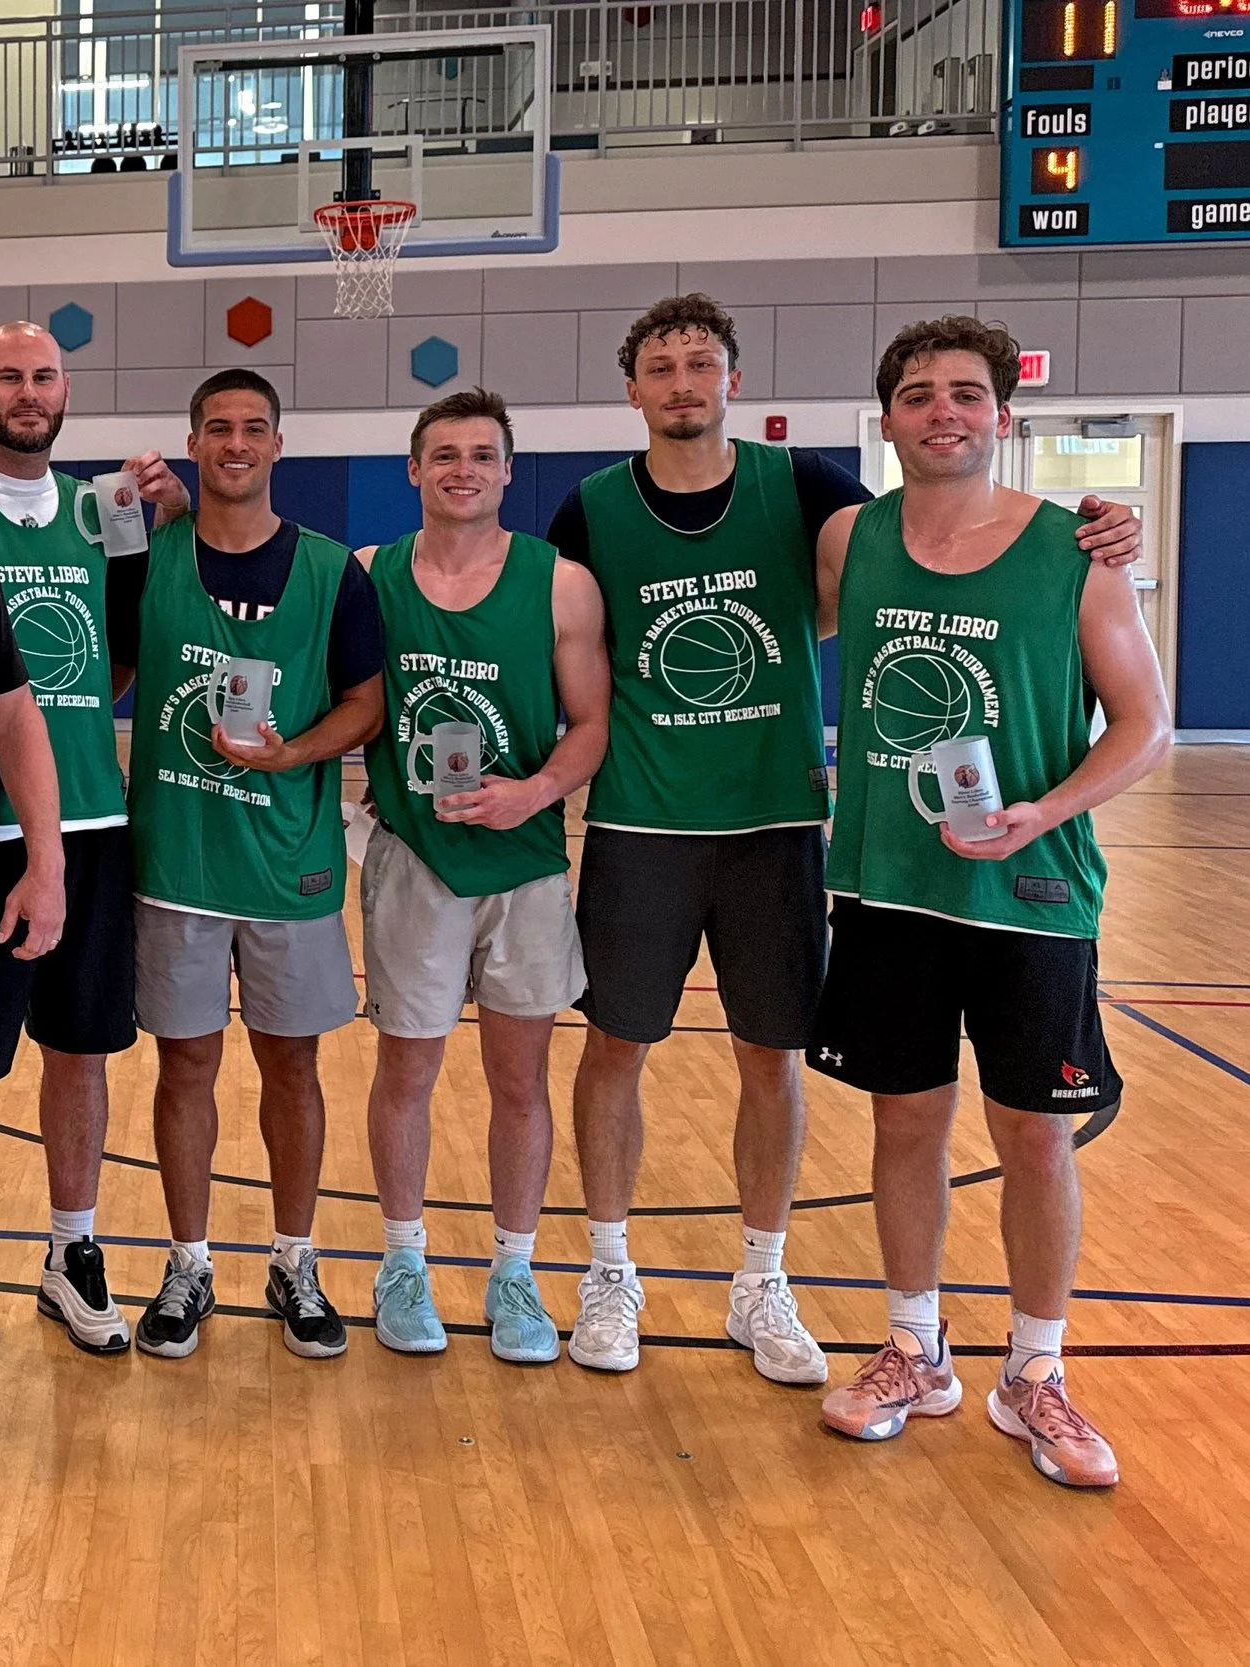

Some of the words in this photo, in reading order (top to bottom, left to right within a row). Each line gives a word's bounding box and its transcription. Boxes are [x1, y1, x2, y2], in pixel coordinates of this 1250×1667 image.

[1187, 56, 1250, 86] perio
[1026, 107, 1087, 136] fouls
[1185, 101, 1250, 130] playe
[1047, 150, 1076, 189] 4
[1032, 209, 1078, 230] won
[1020, 355, 1044, 379] XIT
[48, 566, 90, 585] LIBRO
[640, 577, 698, 604] STEVE
[703, 569, 757, 594] LIBRO
[6, 586, 61, 615] ASKETBALL
[64, 590, 99, 660] TOURNAMENT
[875, 608, 933, 632] STEVE
[937, 613, 999, 640] LIBRO
[638, 640, 653, 679] MEN'S
[646, 597, 717, 641] BASKETBALL
[723, 599, 782, 665] TOURNAMENT
[400, 653, 447, 674] STEVE
[450, 659, 499, 681] LIBRO
[862, 667, 877, 709] MEN'S
[873, 635, 946, 668] BASKETBALL
[950, 644, 999, 728] TOURNAMENT
[36, 694, 54, 706] CITY
[57, 695, 100, 708] RECREATION
[159, 697, 180, 732] MEN'S
[651, 713, 671, 726] SEA
[674, 713, 696, 725] ISLE
[698, 711, 721, 724] CITY
[724, 703, 781, 722] RECREATION
[462, 686, 509, 754] TOURNAMENT
[158, 769, 175, 782] SEA
[178, 774, 199, 788] ISLE
[201, 778, 220, 794] CITY
[1051, 1086, 1100, 1099] BASKETBALL
